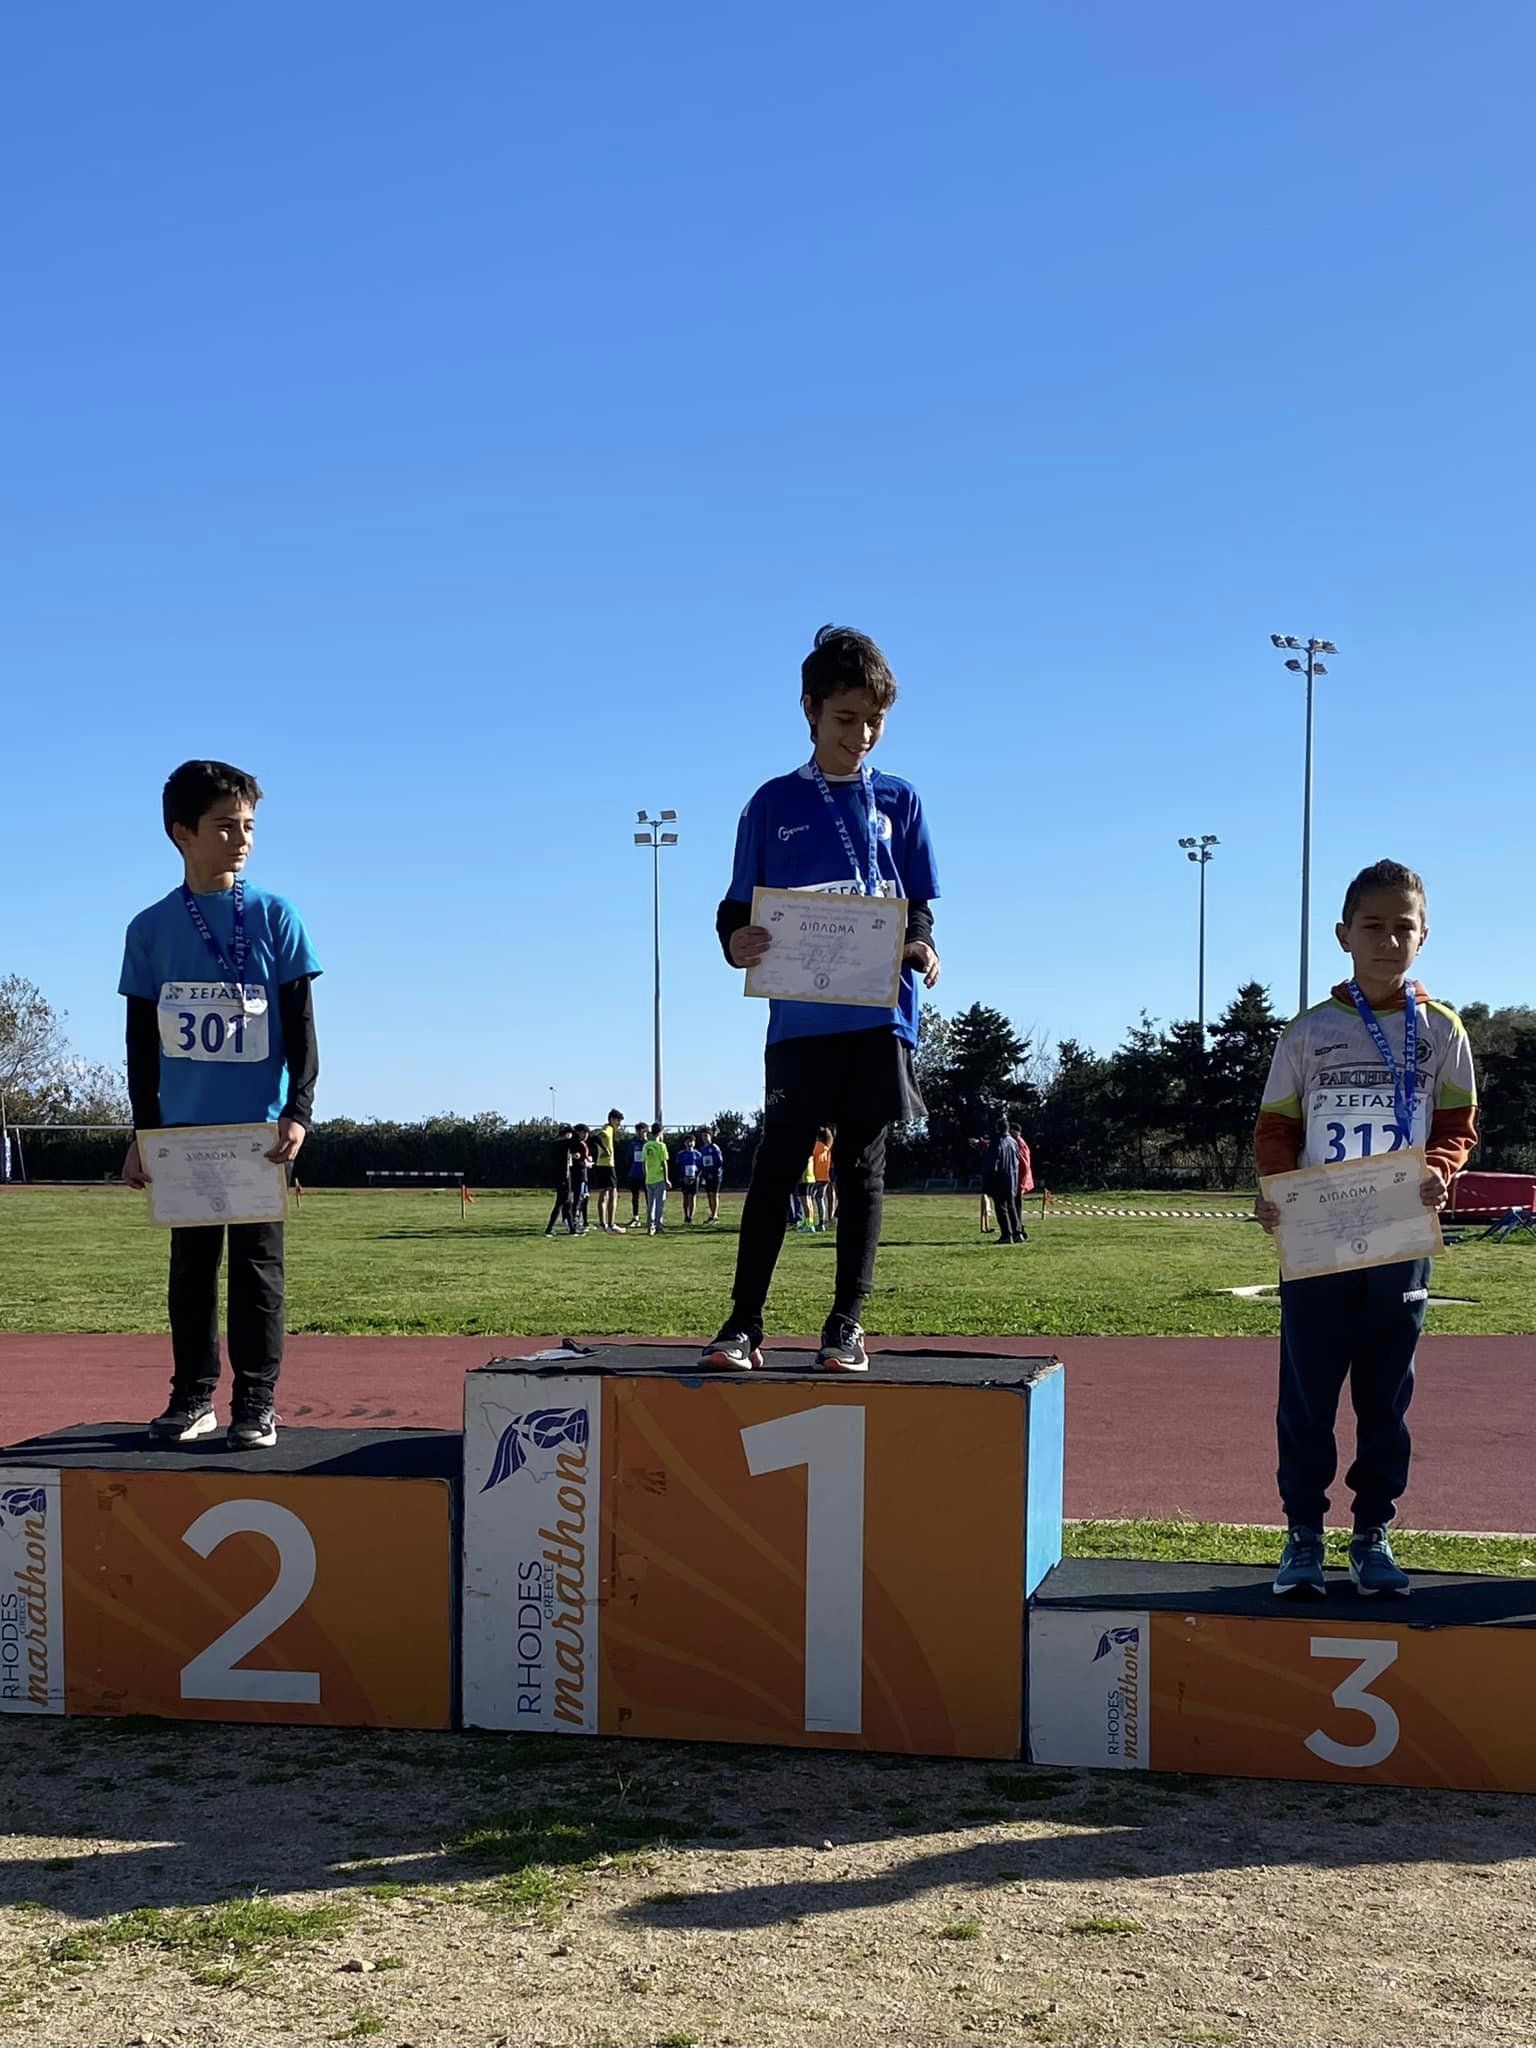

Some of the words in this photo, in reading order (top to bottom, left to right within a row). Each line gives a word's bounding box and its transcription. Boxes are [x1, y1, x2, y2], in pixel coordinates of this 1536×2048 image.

[815, 886, 860, 896] ΕΓΑ
[800, 922, 855, 934] ΔΙΠΛΩΜΑ
[177, 1012, 244, 1053] 301
[1406, 1023, 1415, 1060] ΣΕΓΑΣ
[1335, 1094, 1395, 1107] ΣΕΓΑΣ
[1324, 1122, 1402, 1164] 312
[1319, 1185, 1377, 1203] ΔΙΠΛΩΜΑ
[180, 1498, 320, 1704] 2
[538, 1446, 586, 1726] marathon
[543, 1563, 554, 1620] GREECE
[740, 1404, 866, 1734] 1
[15, 1514, 48, 1707] marathon
[517, 1560, 543, 1714] RHODES
[1, 1593, 19, 1699] RHODES
[1108, 1690, 1119, 1755] RHODES
[1117, 1643, 1138, 1759] marathon
[1303, 1636, 1400, 1768] 3
